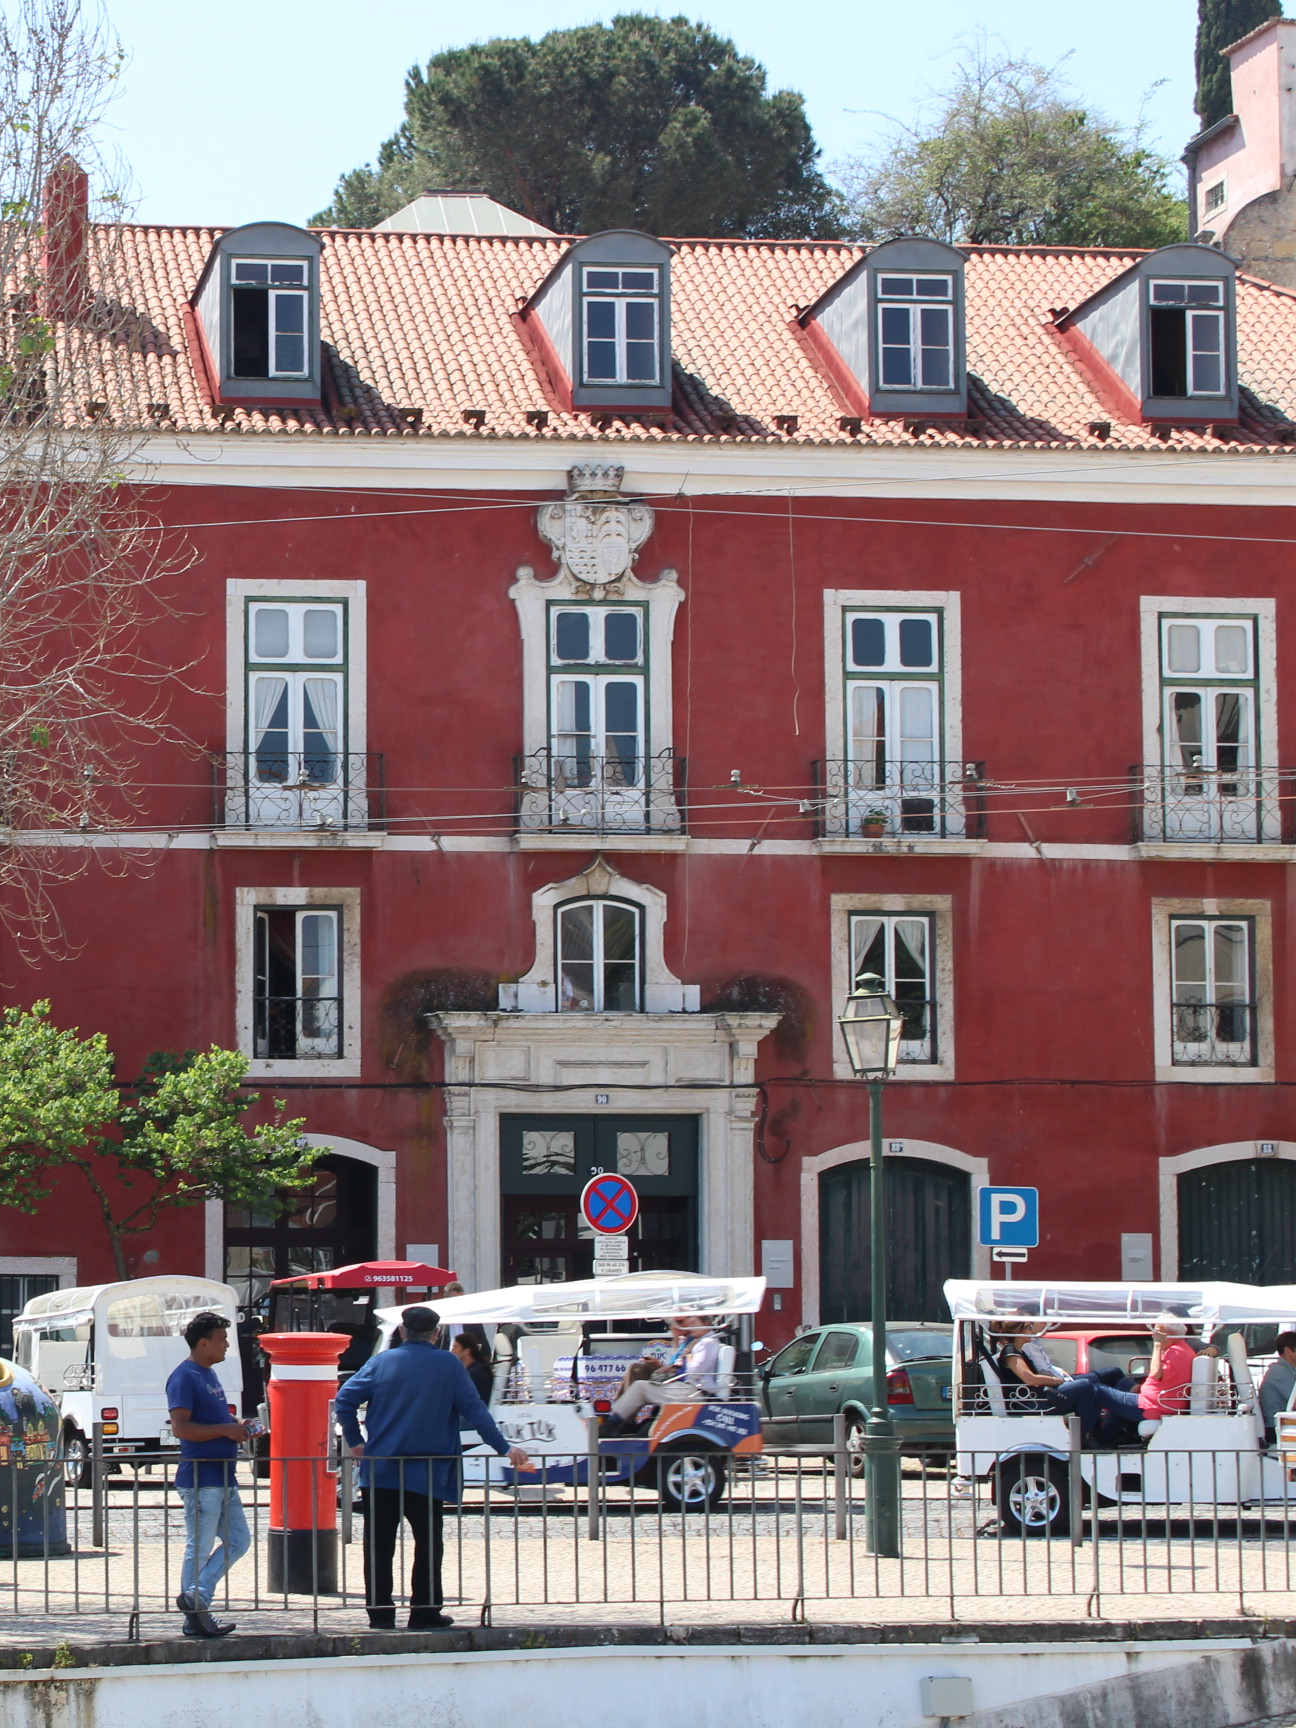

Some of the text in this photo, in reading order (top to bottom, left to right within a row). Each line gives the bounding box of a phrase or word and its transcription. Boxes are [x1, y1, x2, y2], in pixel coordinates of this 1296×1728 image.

[596, 1094, 608, 1105] 90
[990, 1193, 1026, 1240] P
[585, 1364, 626, 1373] 96 477 66
[526, 1419, 557, 1439] TUK
